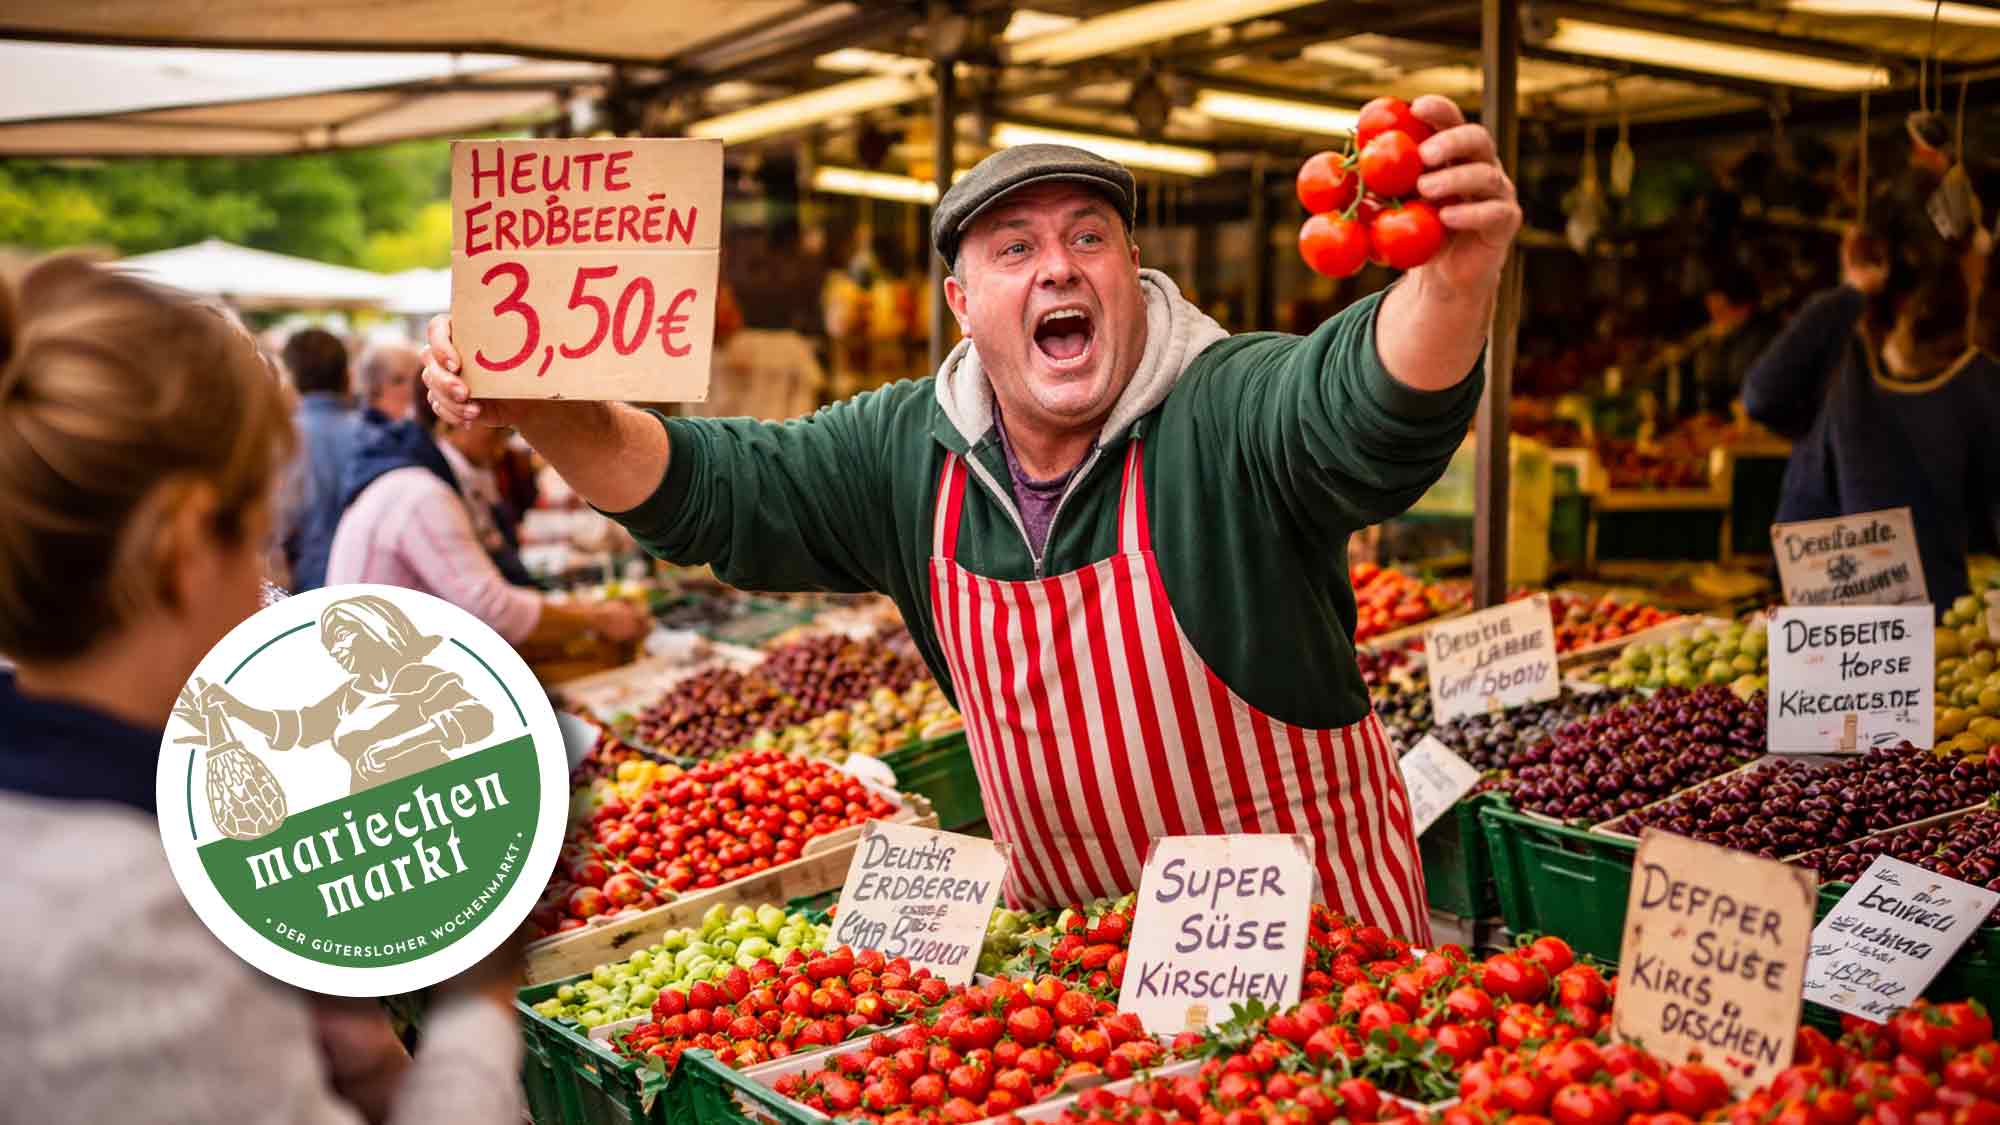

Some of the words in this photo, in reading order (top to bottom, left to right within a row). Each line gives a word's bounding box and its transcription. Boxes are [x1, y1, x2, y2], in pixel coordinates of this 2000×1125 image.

[471, 147, 633, 199] HEUTE
[474, 262, 697, 377] 3,50€
[853, 872, 990, 905] ERDBEREN
[1155, 858, 1286, 910] SUPER
[1175, 913, 1287, 954] SÜSE
